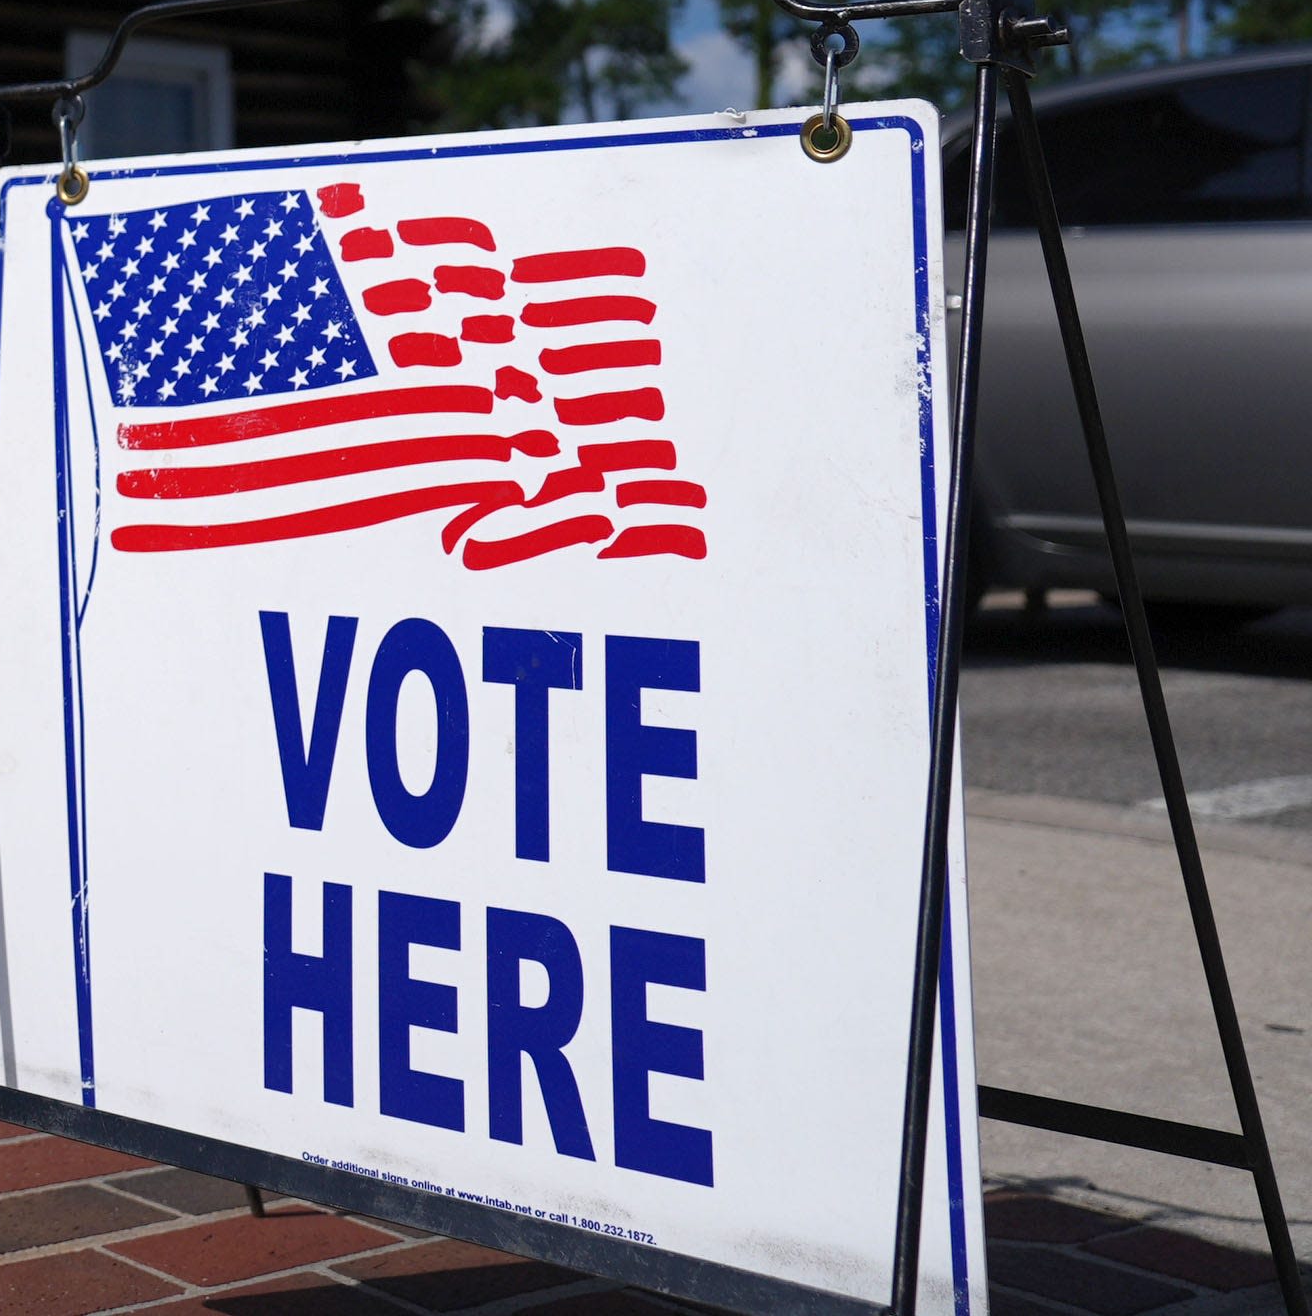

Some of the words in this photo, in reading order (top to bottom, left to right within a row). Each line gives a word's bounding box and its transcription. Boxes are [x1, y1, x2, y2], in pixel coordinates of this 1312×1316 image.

[258, 609, 707, 883] VOTE
[262, 871, 715, 1187] HERE
[302, 1151, 329, 1165] Order
[331, 1159, 379, 1179] additional
[381, 1171, 409, 1185] signs
[411, 1179, 443, 1194] online
[445, 1187, 455, 1197] at
[457, 1189, 532, 1215] www.intab.net
[534, 1208, 546, 1219] or
[549, 1211, 568, 1224] call
[571, 1216, 657, 1245] 1.800.232.1872.
